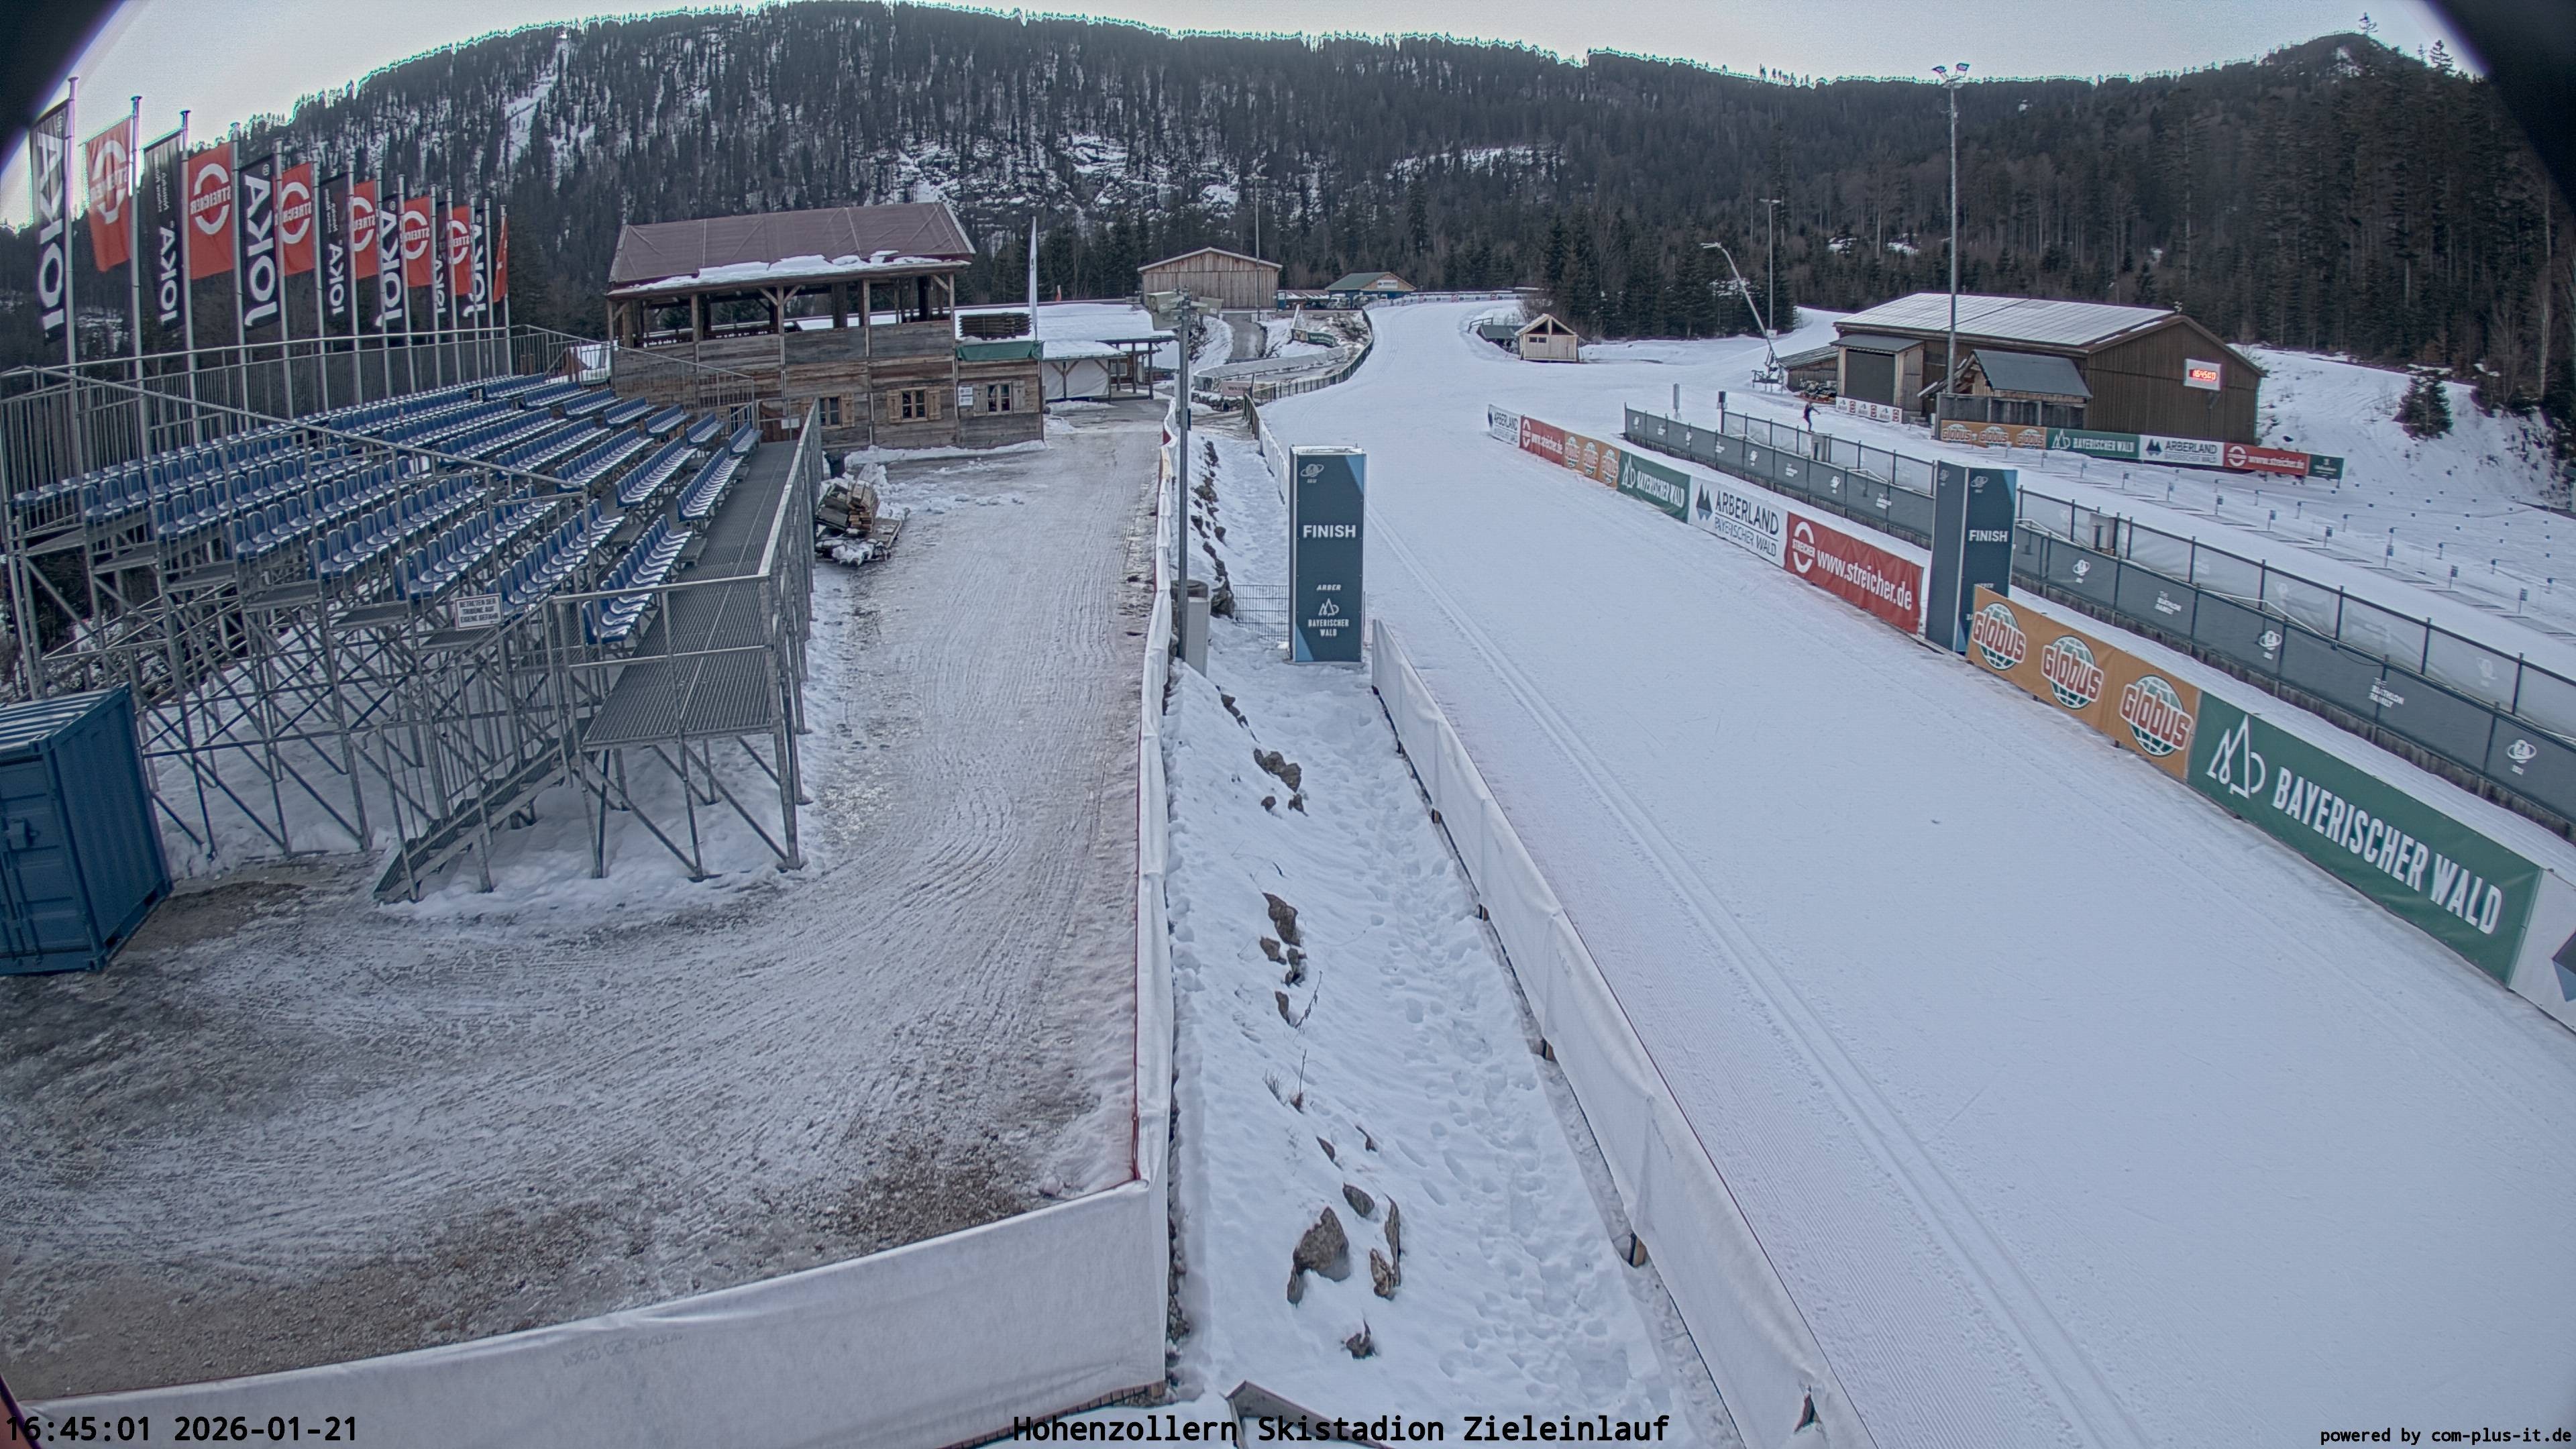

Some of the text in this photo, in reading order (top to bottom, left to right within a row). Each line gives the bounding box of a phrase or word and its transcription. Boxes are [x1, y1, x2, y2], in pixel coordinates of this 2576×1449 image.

[2073, 439, 2135, 453] BAYERISCHER WALD
[2165, 441, 2217, 454] ARBERLAND
[1637, 471, 1685, 508] BAYERISCHER WALD
[1715, 490, 1778, 535] ARBERLAND
[1303, 525, 1356, 539] FINISH
[1715, 517, 1777, 557] BAYERISCHER WALD
[1968, 529, 2008, 542] FINISH
[1817, 550, 1912, 610] www.streicher.de
[1308, 619, 1349, 627] BAYERISCHER
[1320, 629, 1337, 637] WALD
[2272, 766, 2502, 934] BAYERISCHER WALD
